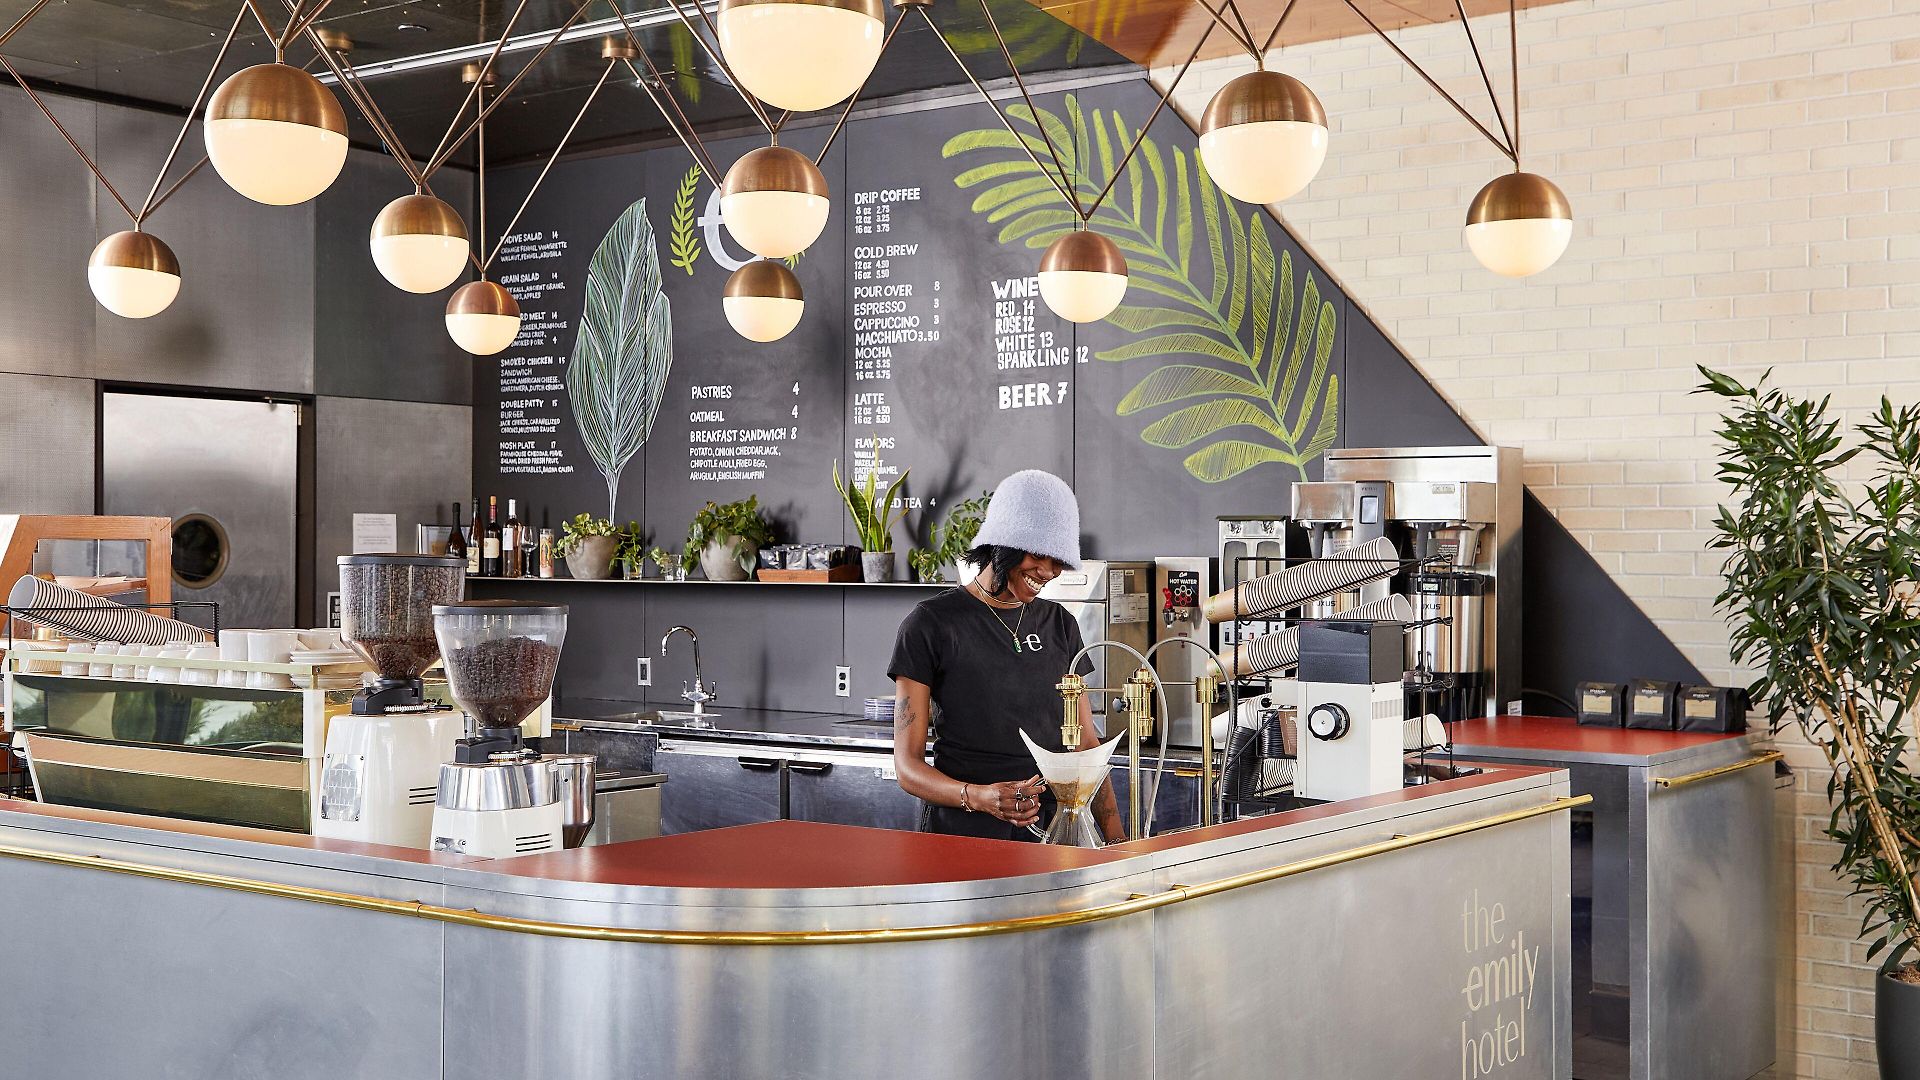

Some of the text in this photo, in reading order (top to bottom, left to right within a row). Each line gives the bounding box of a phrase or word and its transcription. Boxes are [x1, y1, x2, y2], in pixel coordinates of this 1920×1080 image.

[854, 188, 920, 204] DRIP COFFEE
[856, 206, 861, 215] 8
[877, 205, 890, 214] 2.75
[855, 216, 862, 224] 12
[855, 225, 862, 234] 16
[877, 224, 890, 233] 3.75
[523, 232, 543, 242] SALAD
[552, 231, 558, 239] 14
[854, 244, 918, 259] COLD BREW
[854, 261, 862, 270] 12
[876, 260, 890, 269] 4.50
[501, 274, 519, 284] GRAIN
[520, 272, 540, 283] SALAD
[854, 271, 862, 280] 16
[854, 280, 940, 299] POUR OVER 8
[991, 277, 1039, 299] WINE
[854, 298, 939, 316] ESPRESSO 3
[995, 300, 1035, 317] RED 14
[529, 311, 546, 320] MELT
[551, 311, 558, 320] 14
[854, 315, 939, 331] CAPPUCCINO 3
[995, 312, 1035, 334] ROSÉ 12
[855, 329, 940, 346] MACCHIATO 3.50
[995, 332, 1053, 352] WHITE 13
[855, 346, 892, 359] MOCHA
[997, 346, 1088, 369] SPARKLING 12
[501, 357, 525, 367] SMOKED
[527, 356, 553, 366] CHICKEN
[855, 360, 863, 369] 12
[876, 359, 891, 368] 5.25
[501, 368, 532, 376] SANDWICH
[855, 371, 864, 380] 16
[876, 370, 891, 379] 5.75
[691, 382, 800, 399] PASTRIES 4
[999, 382, 1068, 409] BEER 7
[501, 400, 524, 409] DOUBLE
[525, 399, 544, 408] PATTY
[855, 393, 884, 405] LATTE
[500, 411, 524, 419] BURGER
[690, 405, 798, 422] OATMEAL 4
[854, 407, 862, 415] 12
[876, 406, 890, 415] 4.50
[854, 416, 862, 424] 16
[876, 415, 890, 424] 5.50
[690, 427, 797, 443] BREAKFAST SANDWICH 8
[500, 442, 517, 450] NOSH
[518, 441, 535, 450] PLATE
[715, 447, 734, 456] ONION
[690, 460, 717, 468] CHIPOTLE
[736, 459, 752, 467] FRIED
[718, 471, 741, 480] ENGLISH
[742, 471, 765, 480] MUFFIN
[904, 498, 922, 508] TEA
[929, 497, 936, 506] 4
[1022, 633, 1043, 651] e
[1461, 888, 1505, 953] the
[1461, 930, 1539, 1011] emily
[1462, 996, 1525, 1080] hotel
